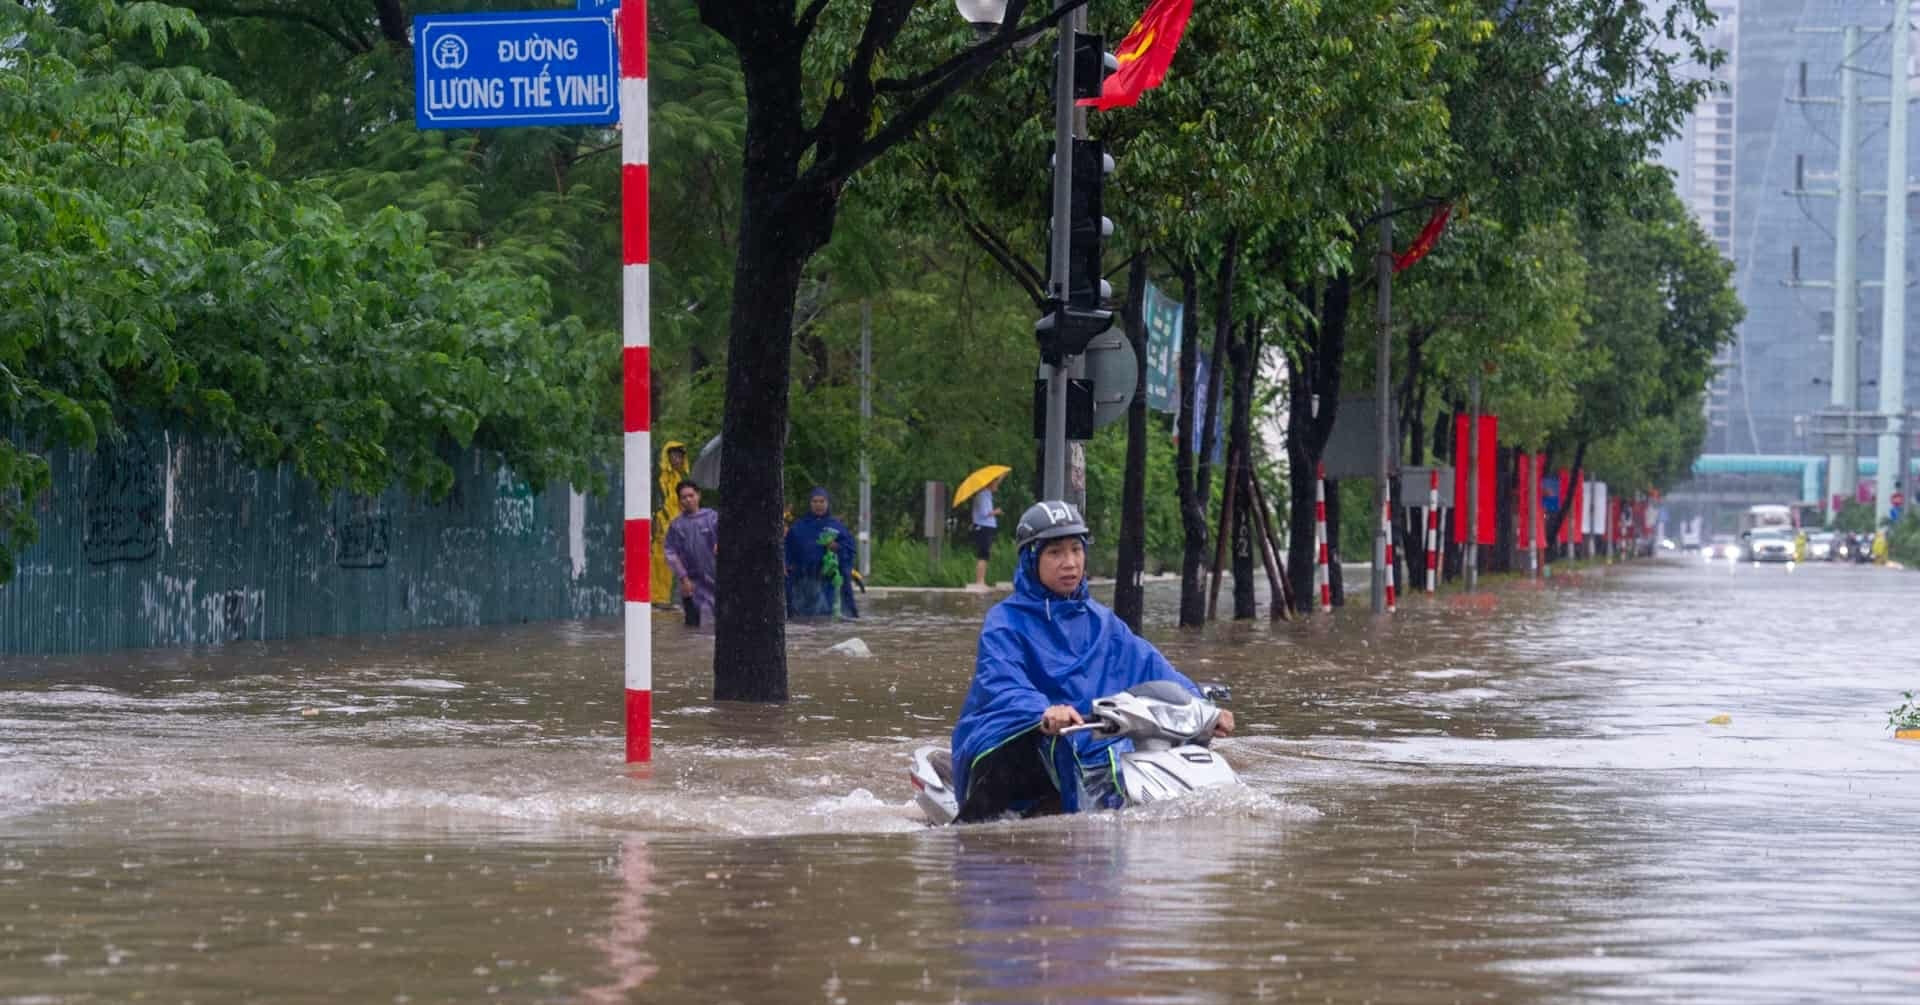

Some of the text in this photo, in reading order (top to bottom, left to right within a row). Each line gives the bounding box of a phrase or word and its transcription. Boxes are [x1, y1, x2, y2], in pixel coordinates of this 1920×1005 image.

[497, 33, 578, 63] ĐƯỜNG
[428, 64, 609, 110] LƯƠNG THẾ VINH
